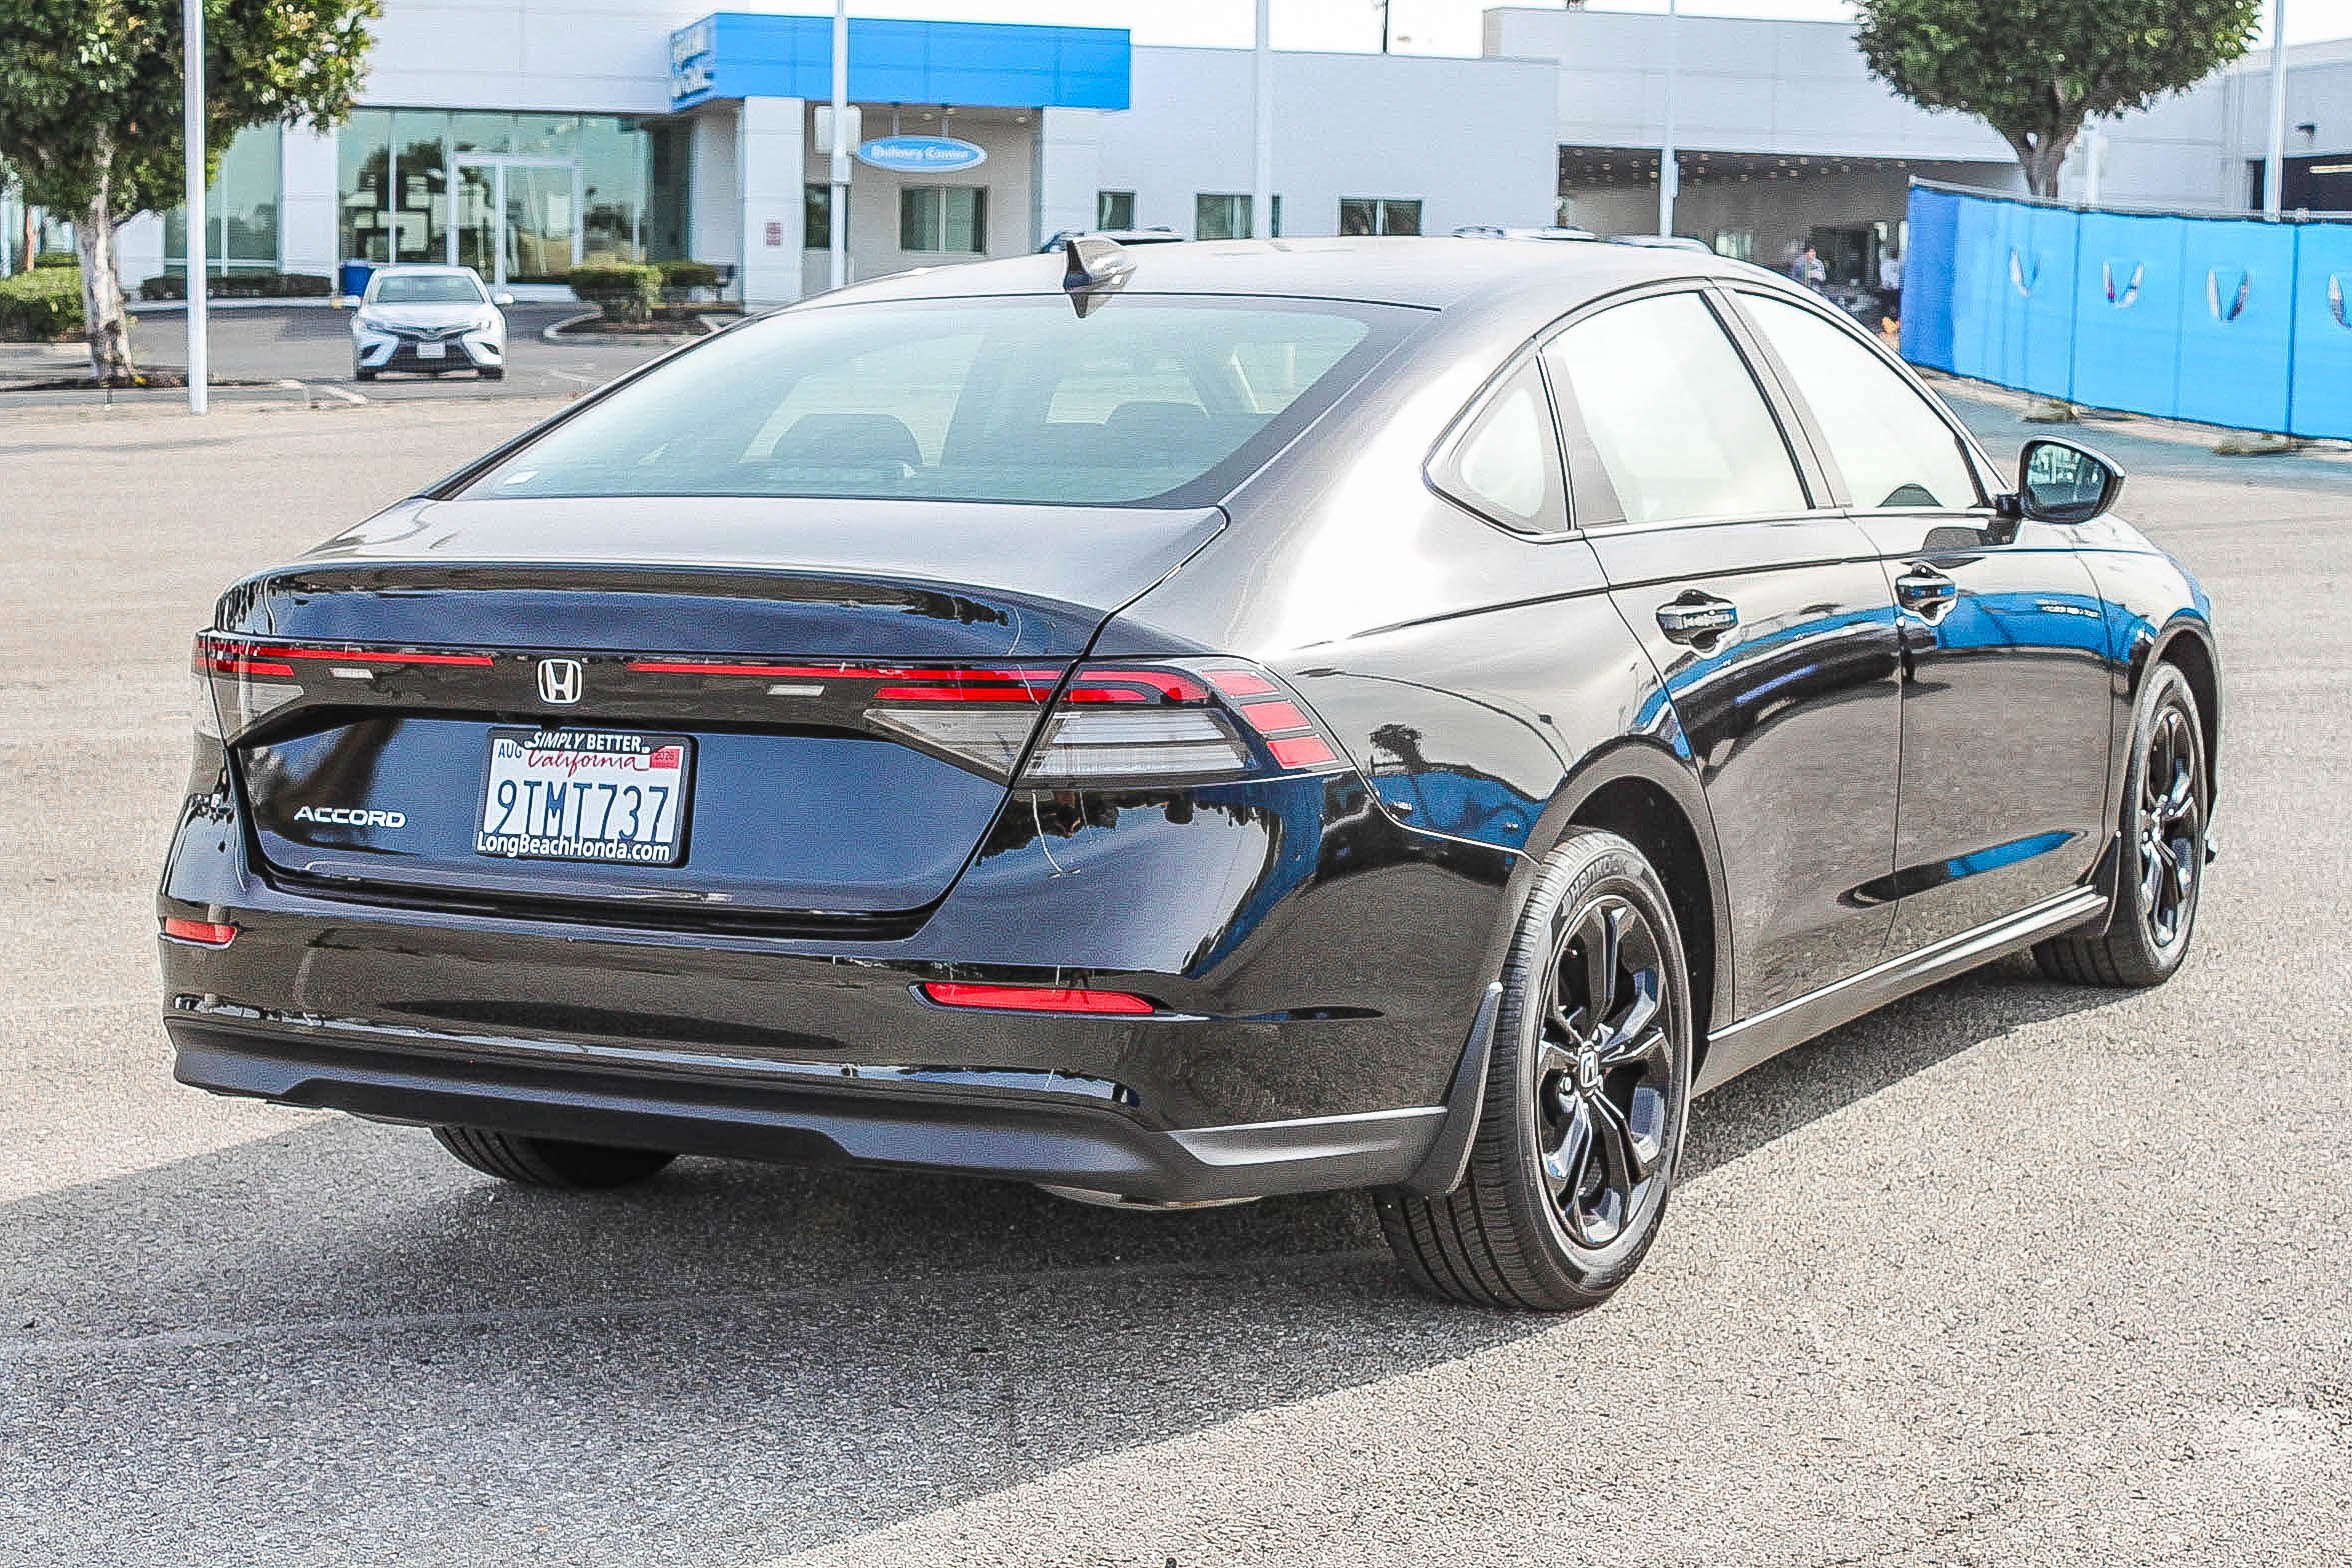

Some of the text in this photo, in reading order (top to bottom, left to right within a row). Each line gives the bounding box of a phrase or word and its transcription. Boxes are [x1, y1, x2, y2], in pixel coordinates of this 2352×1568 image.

[498, 742, 522, 758] AUG
[524, 731, 585, 749] SIMPLY
[528, 749, 649, 777] California
[294, 806, 406, 828] ACCORD
[497, 779, 669, 842] 9TMT737
[477, 831, 670, 861] LongBeachHonda.com
